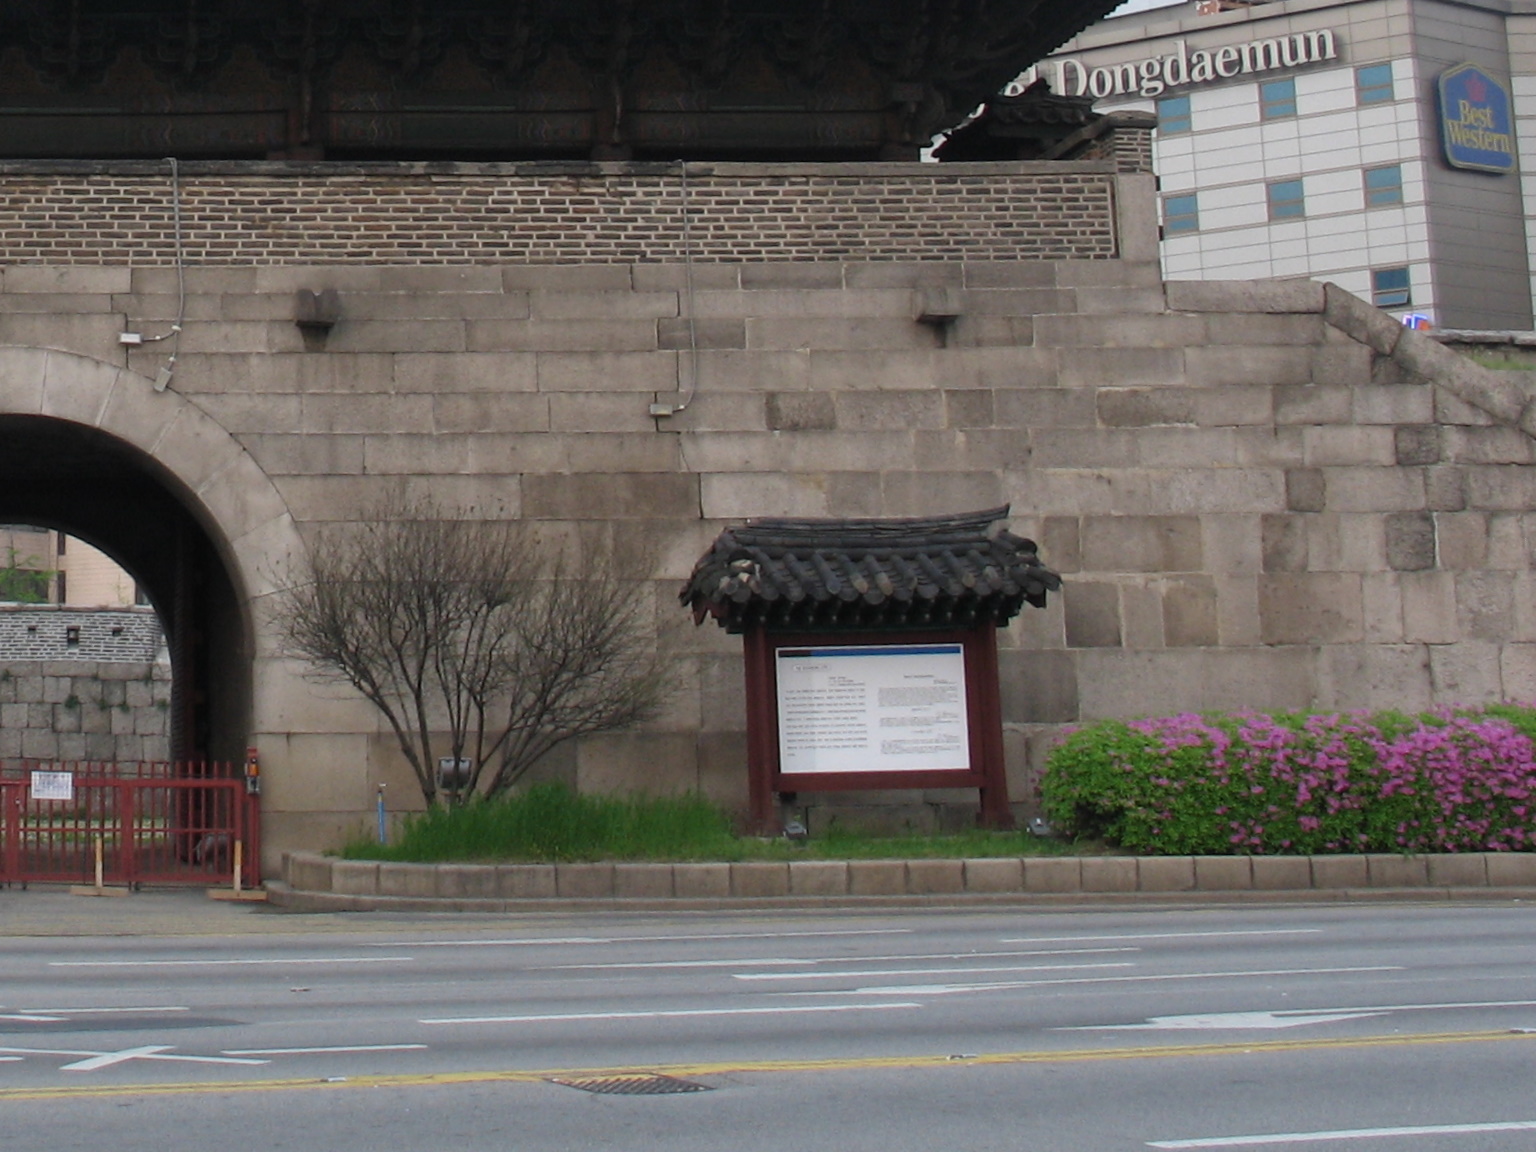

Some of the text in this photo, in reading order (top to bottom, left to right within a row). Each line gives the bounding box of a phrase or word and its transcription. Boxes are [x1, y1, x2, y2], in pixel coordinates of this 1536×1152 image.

[1054, 28, 1337, 98] Dongdaemun
[1458, 100, 1494, 128] Best
[1447, 119, 1510, 153] Western
